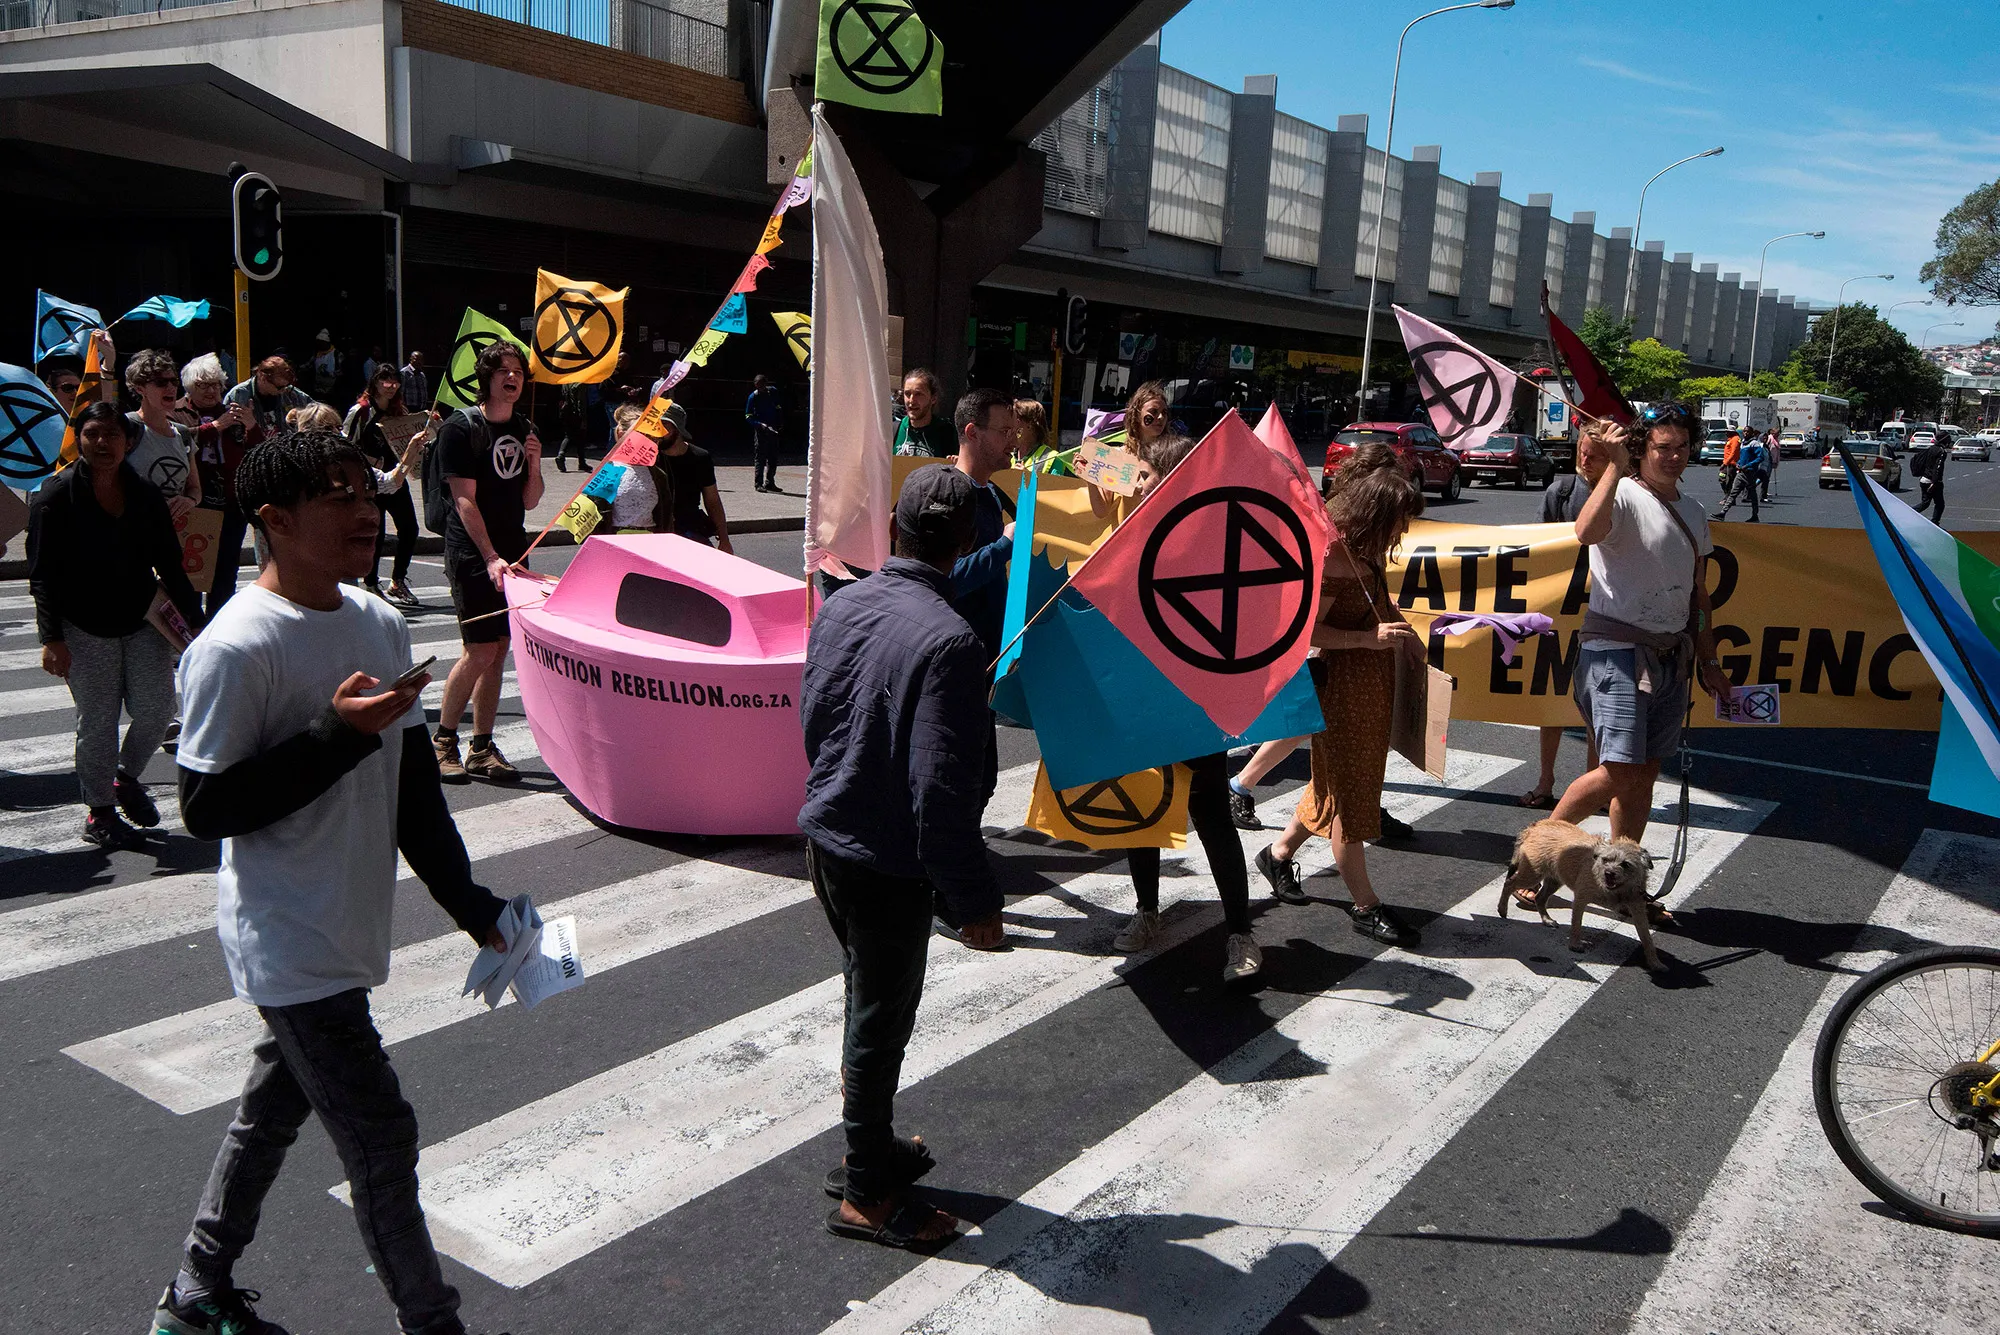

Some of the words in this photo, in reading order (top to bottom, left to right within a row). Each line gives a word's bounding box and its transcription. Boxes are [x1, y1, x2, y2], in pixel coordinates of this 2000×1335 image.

[1398, 545, 1530, 613] ATE
[1559, 544, 1740, 615] AD
[524, 634, 602, 688] EXTINCTION
[611, 670, 791, 708] REBELLION.ORG.ZA
[1489, 624, 1944, 702] EMGENC
